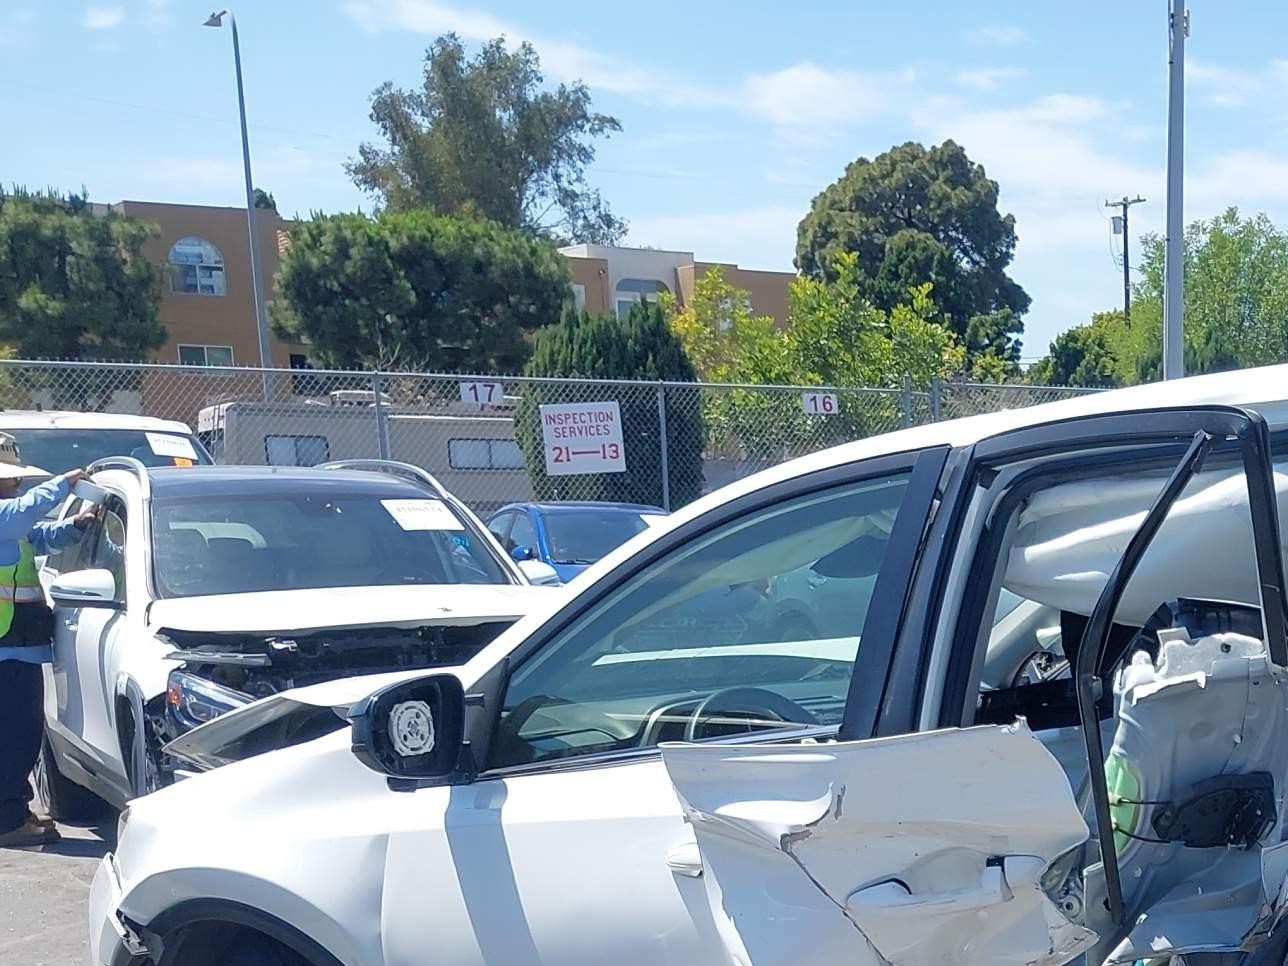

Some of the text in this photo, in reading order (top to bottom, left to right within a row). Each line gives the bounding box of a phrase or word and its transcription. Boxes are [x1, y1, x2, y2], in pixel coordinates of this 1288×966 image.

[468, 383, 496, 402] 17
[809, 395, 833, 412] 16
[544, 411, 614, 426] INSPECTION
[553, 424, 611, 438] SERVICES
